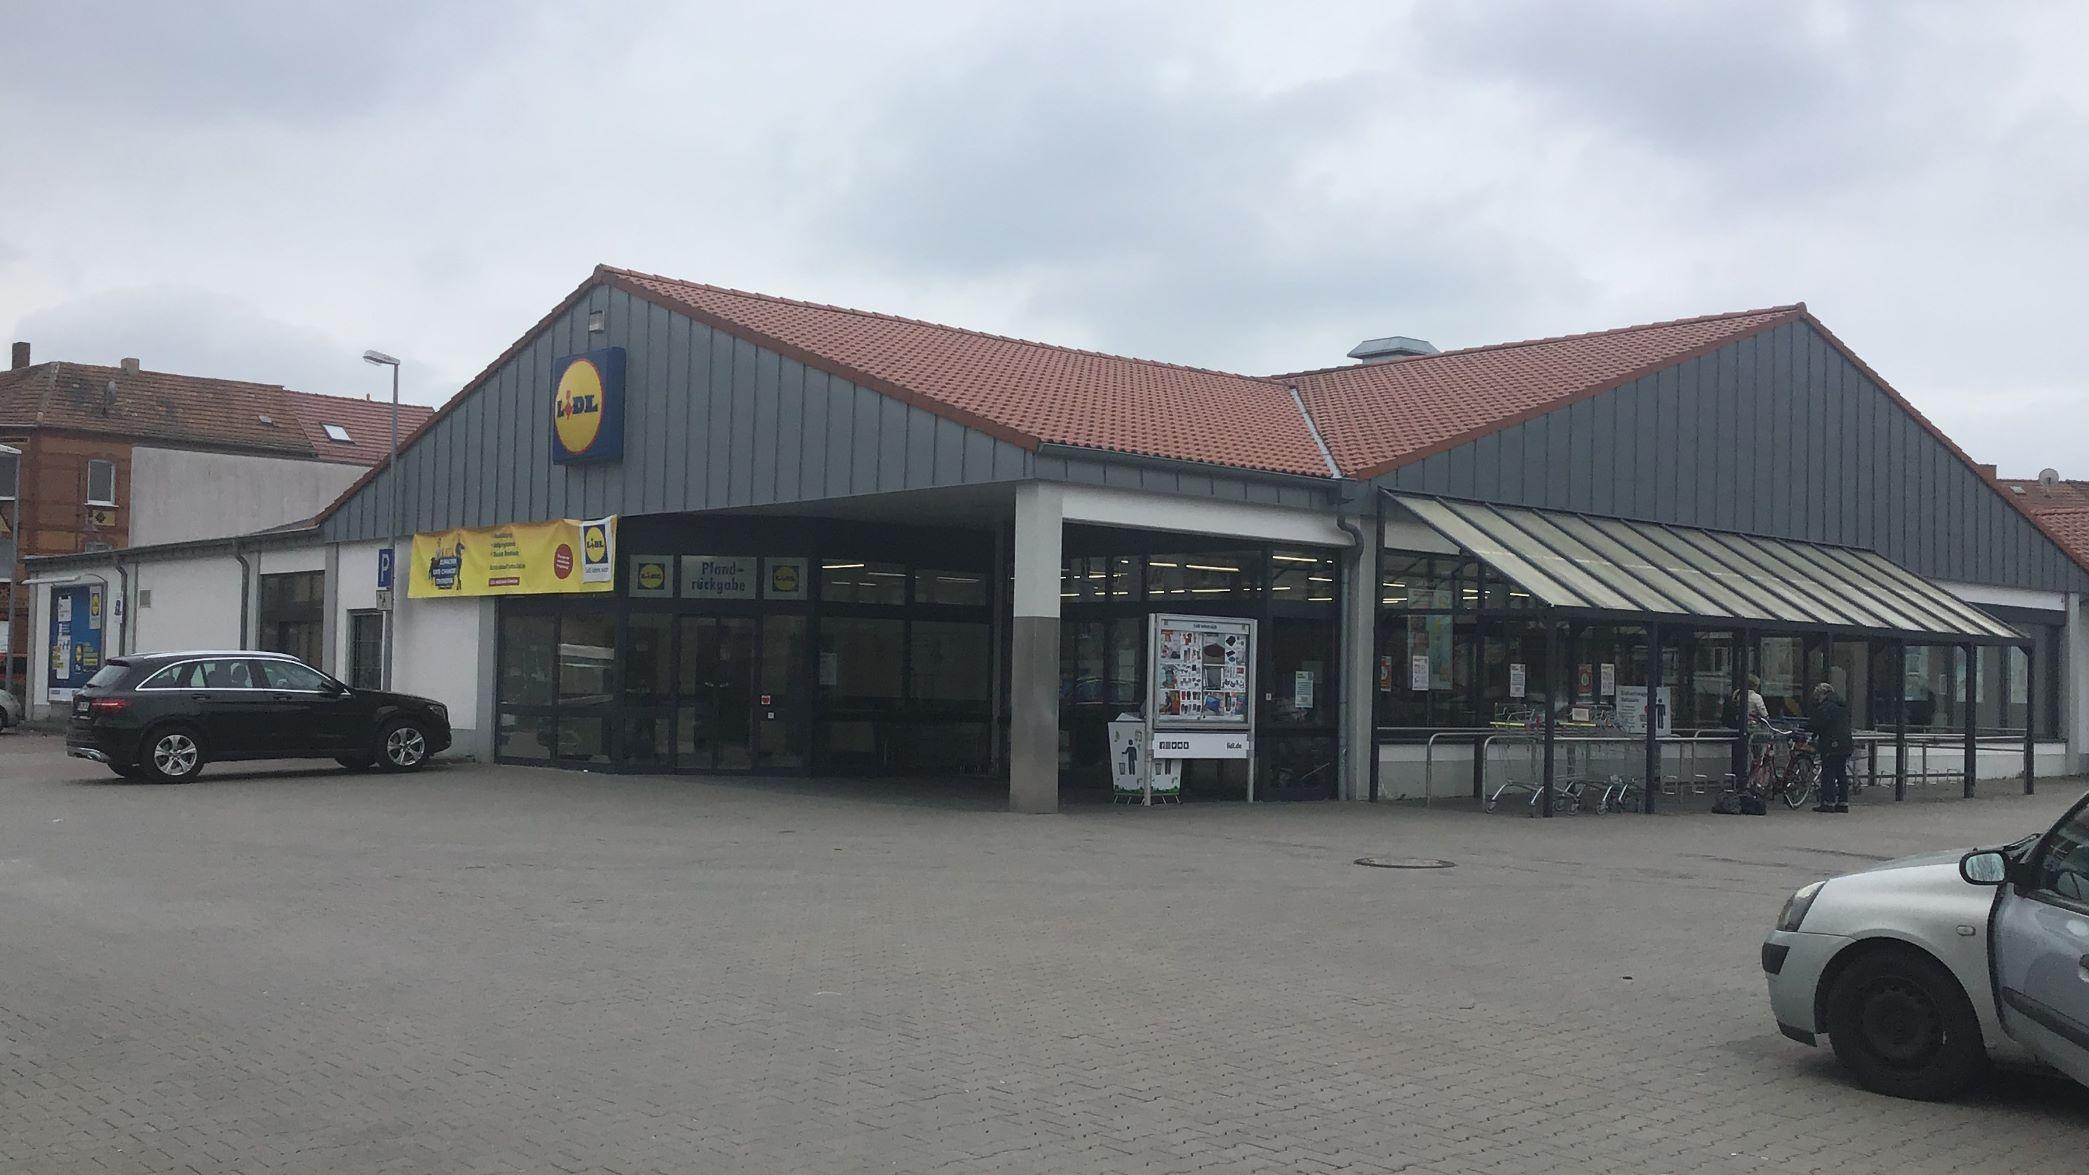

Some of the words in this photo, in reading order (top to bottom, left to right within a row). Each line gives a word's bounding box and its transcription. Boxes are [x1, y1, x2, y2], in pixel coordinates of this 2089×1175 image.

[381, 553, 390, 582] P
[702, 562, 745, 576] Pfand-
[691, 577, 746, 594] rückgabe
